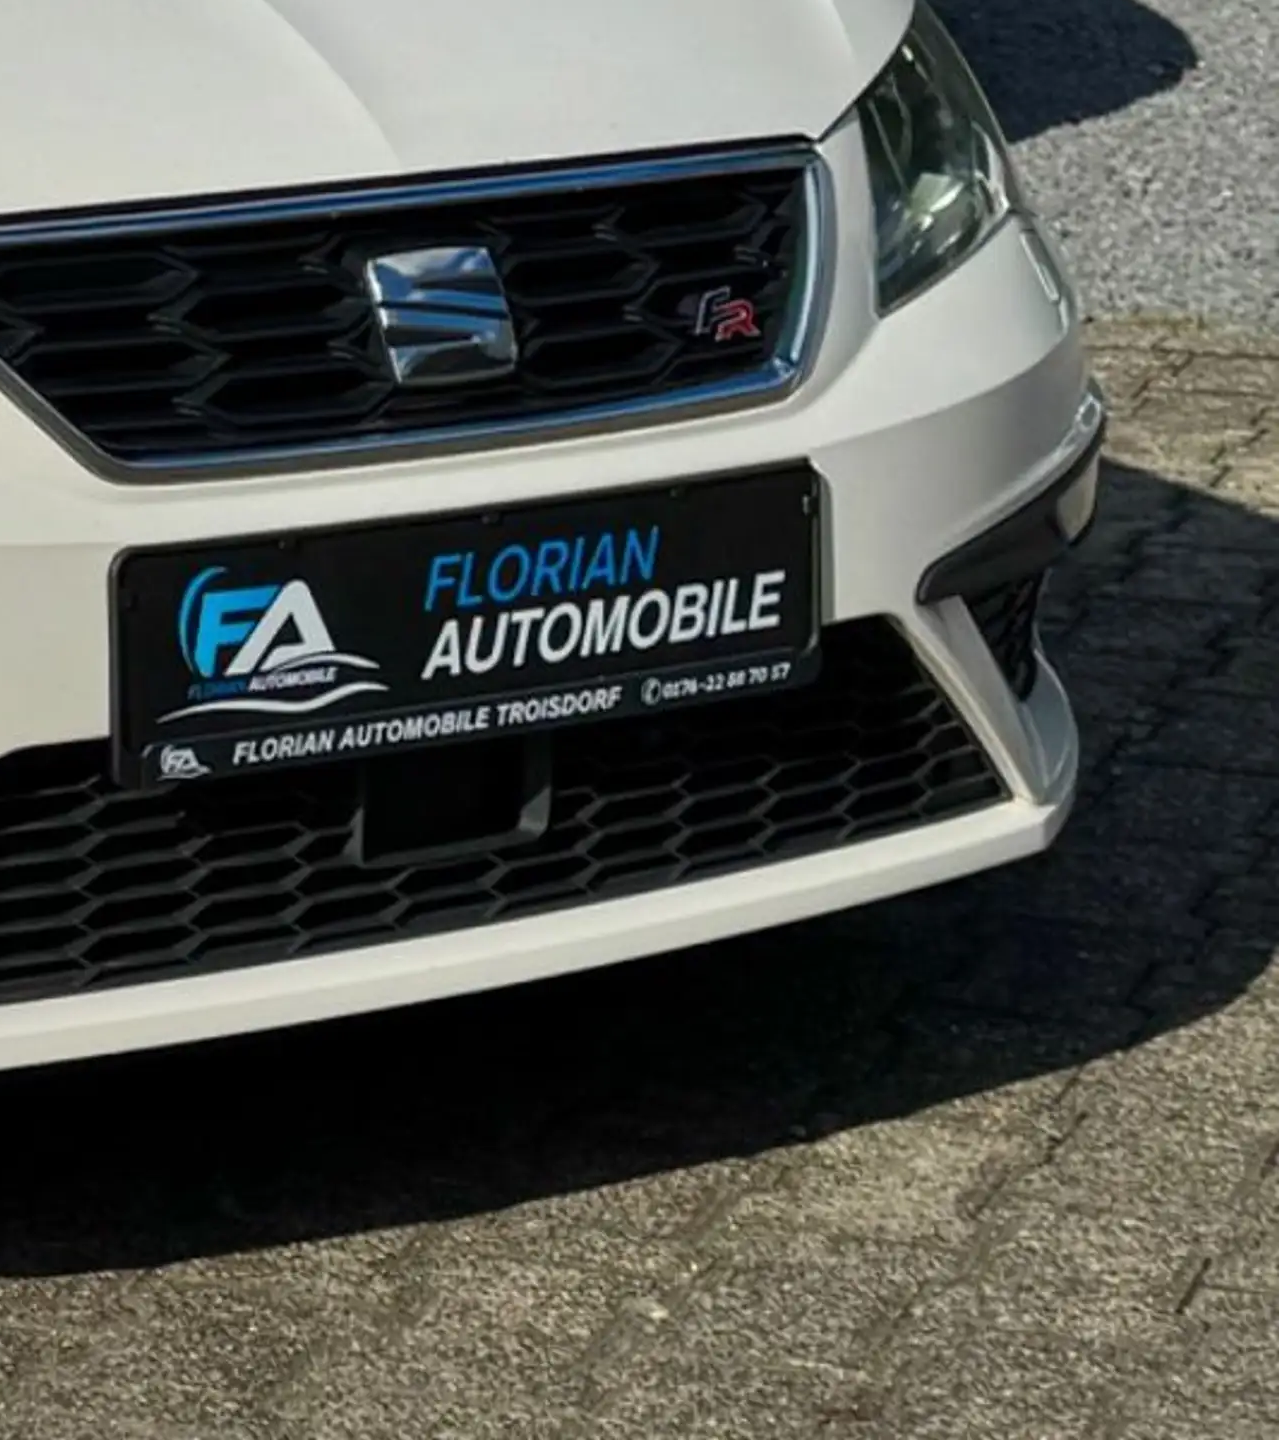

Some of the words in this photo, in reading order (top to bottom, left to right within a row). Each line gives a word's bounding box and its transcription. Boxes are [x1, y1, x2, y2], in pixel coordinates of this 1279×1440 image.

[424, 524, 660, 611] FLORIAN
[194, 579, 337, 678] FA
[421, 569, 787, 681] AUTOMOBILE
[248, 667, 338, 693] AUTOMOBILE
[233, 729, 336, 765] FLORIAN
[338, 705, 491, 750] AUTOMOBILE
[496, 686, 623, 727] TROISDORF
